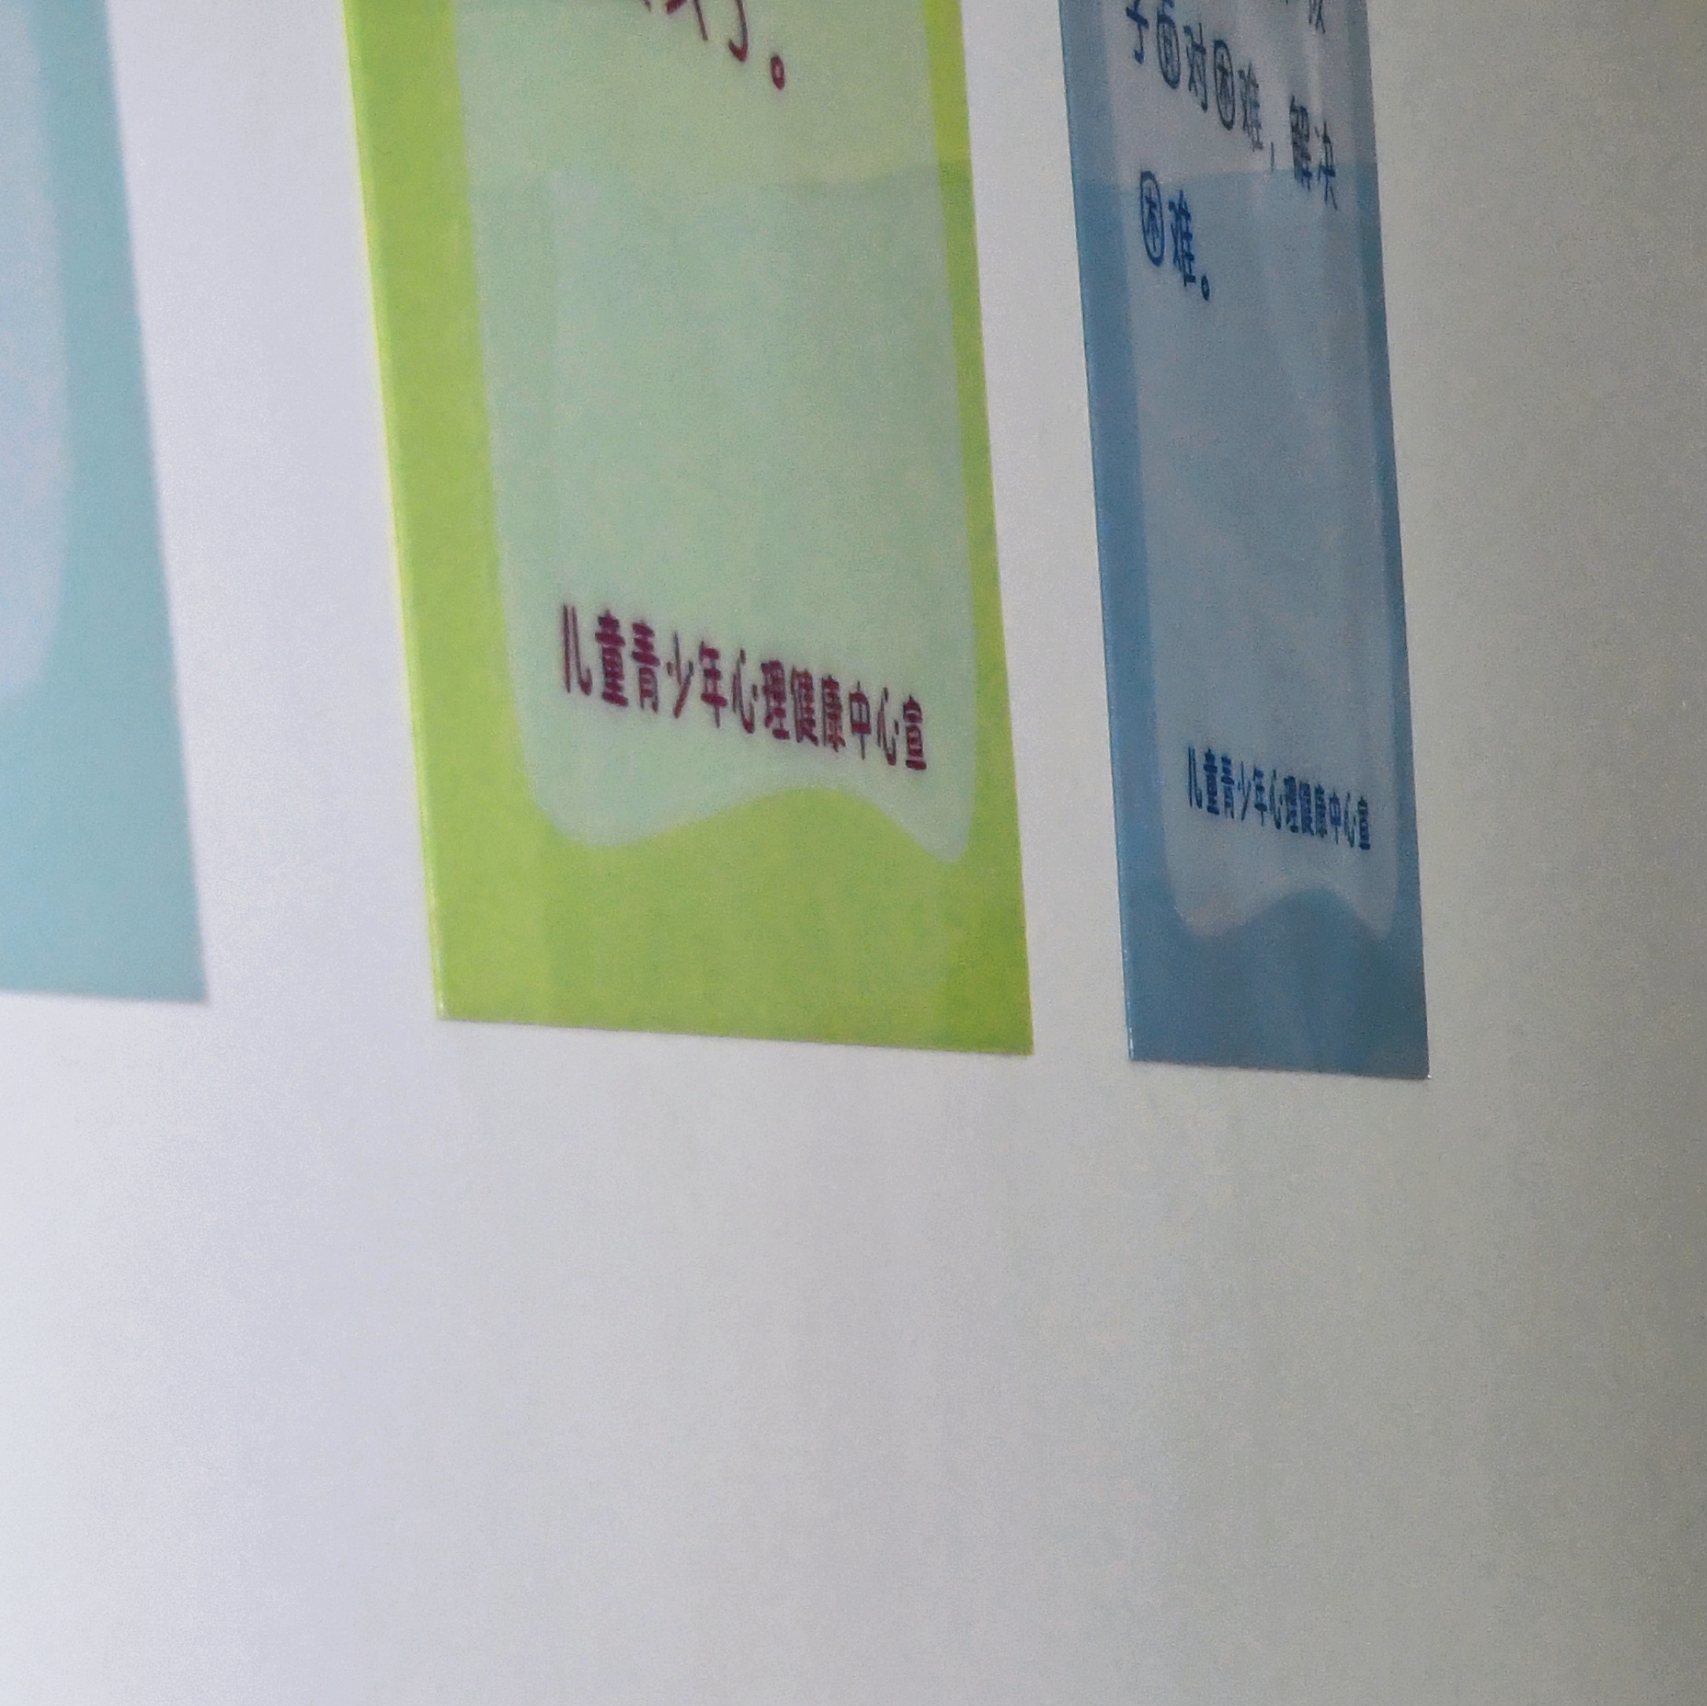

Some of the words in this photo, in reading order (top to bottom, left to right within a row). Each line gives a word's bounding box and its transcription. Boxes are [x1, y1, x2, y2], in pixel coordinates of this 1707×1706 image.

[562, 603, 927, 771] 儿童青少年心理健康中心宣
[1187, 746, 1371, 850] 儿童青少年心理健康中心宣
